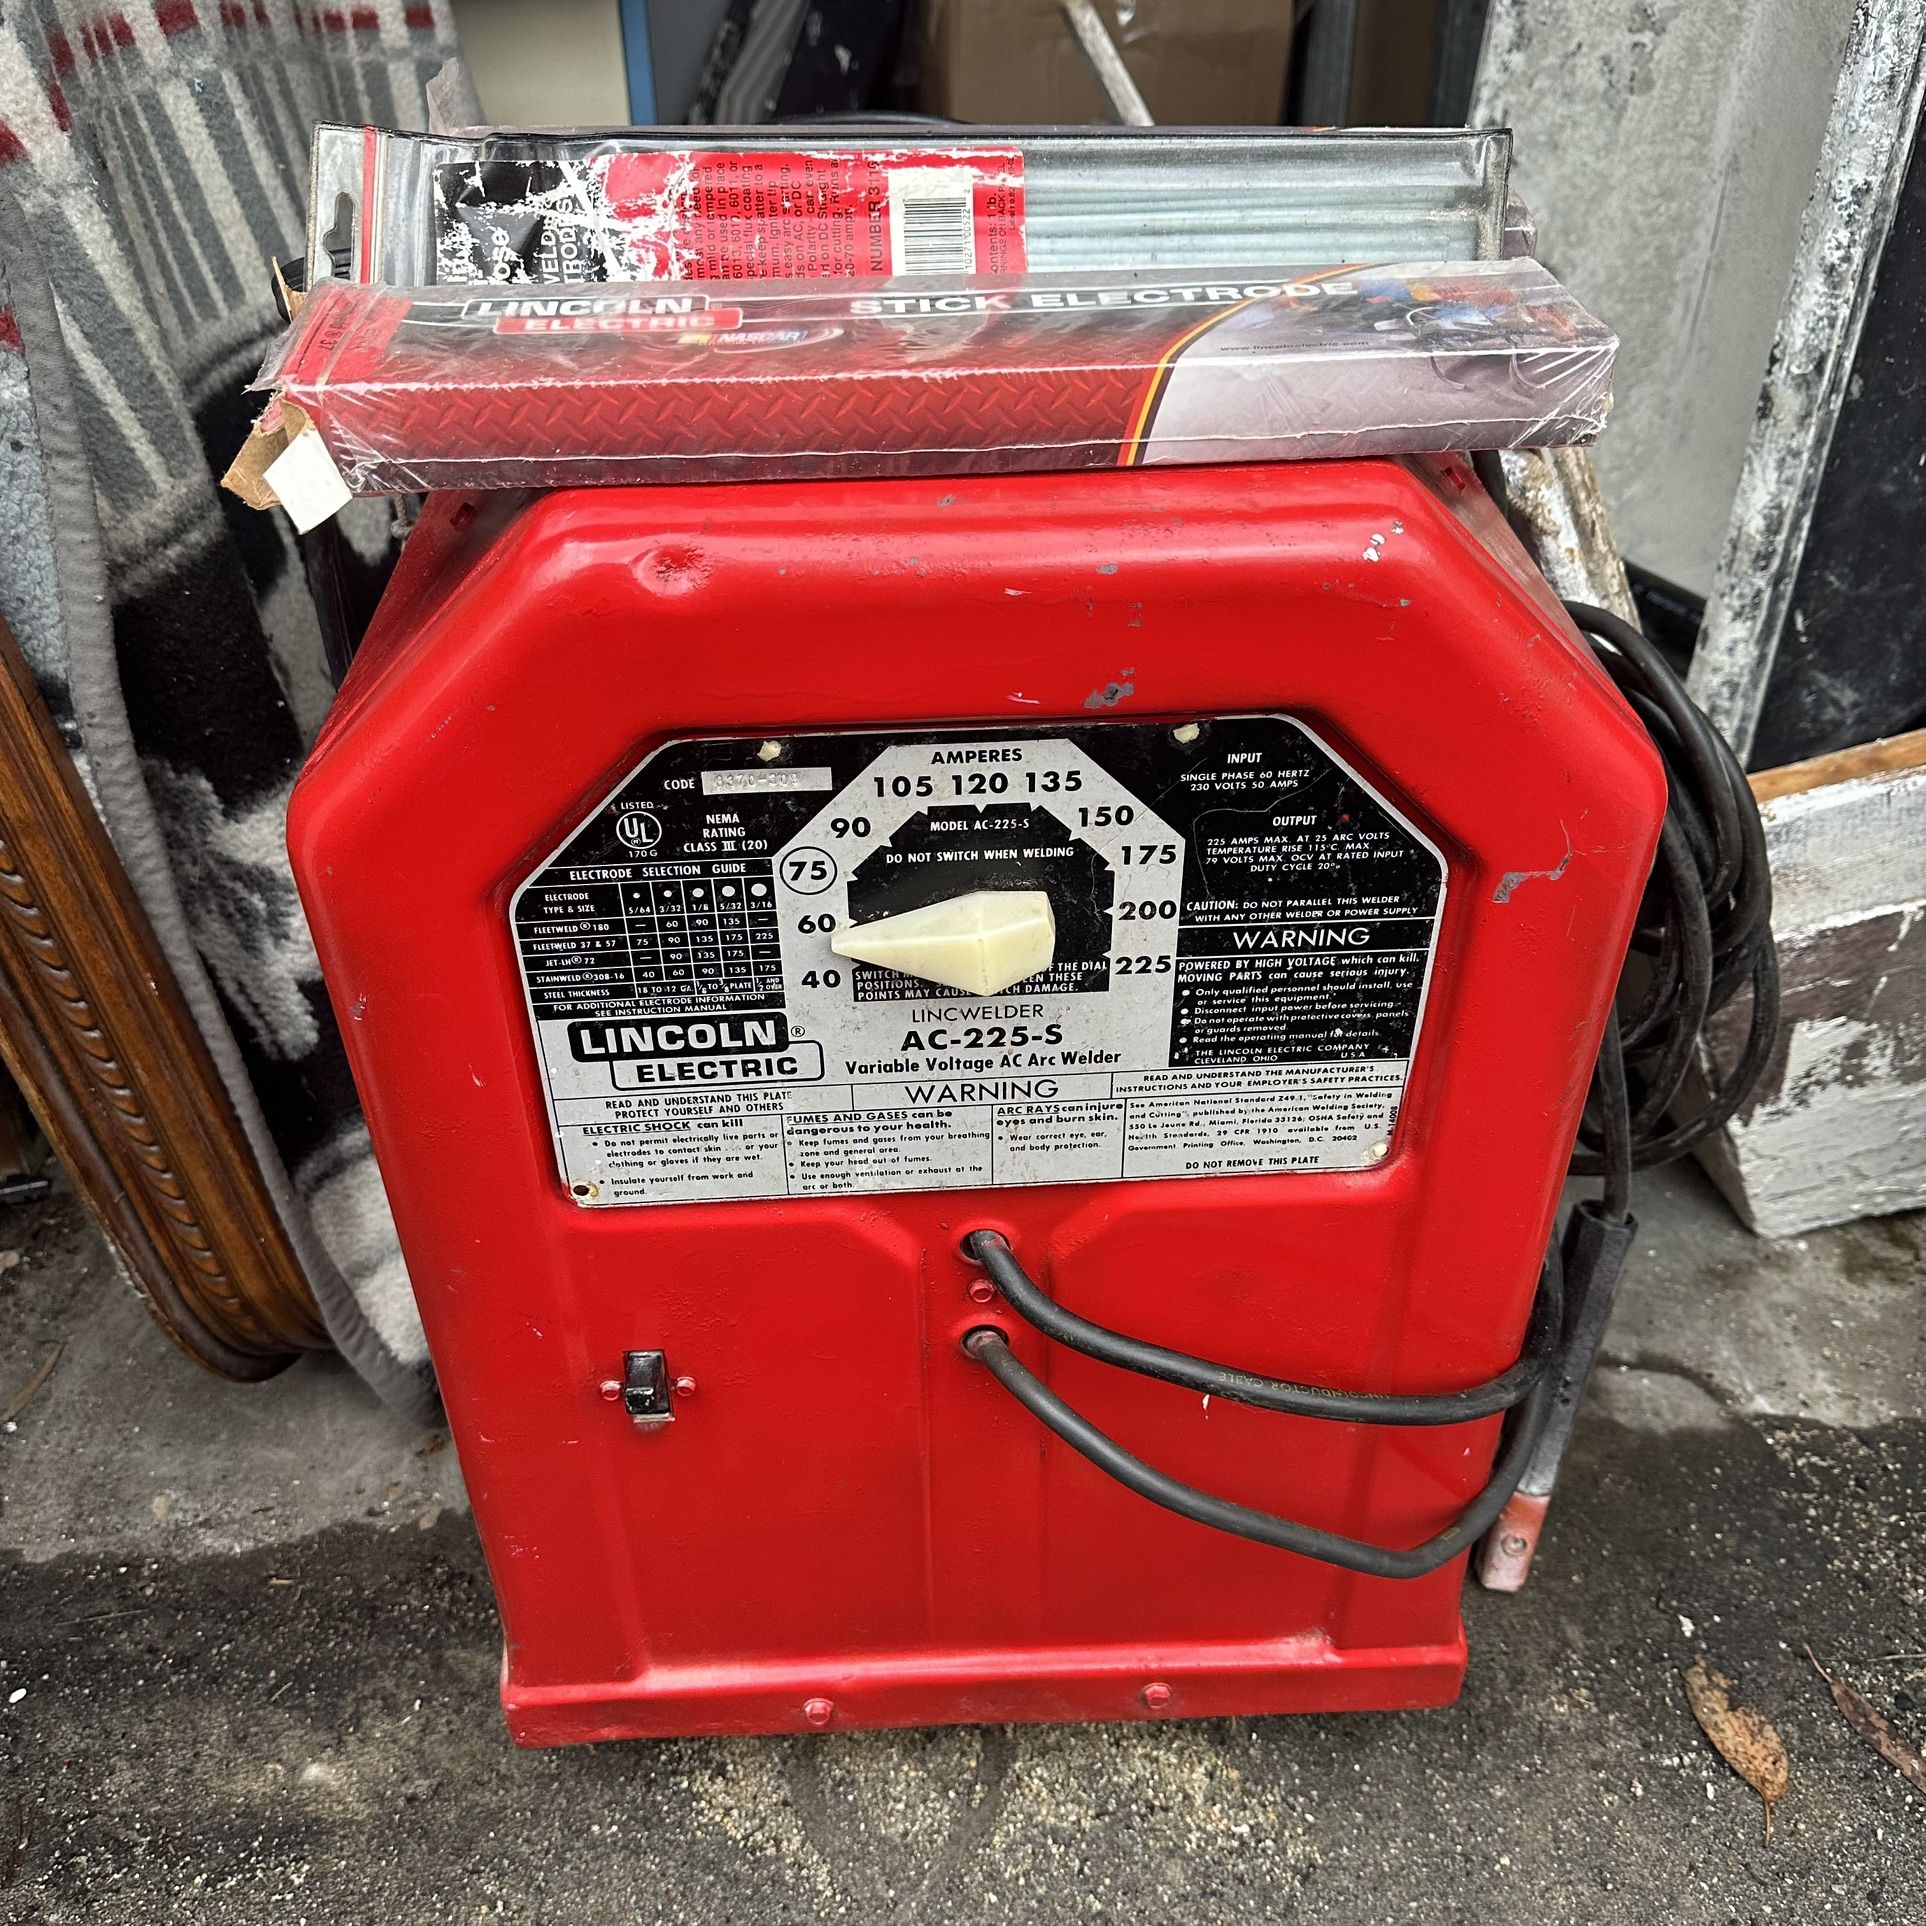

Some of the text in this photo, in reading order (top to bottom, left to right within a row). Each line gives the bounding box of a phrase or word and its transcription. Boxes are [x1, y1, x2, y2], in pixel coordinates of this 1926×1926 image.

[868, 201, 883, 272] NUMBER
[783, 241, 794, 269] easy
[795, 246, 804, 260] on
[848, 281, 1359, 316] STICK ELECTRODE
[477, 298, 693, 317] LINCOLN
[524, 316, 716, 331] ELECTRIC
[930, 748, 1022, 763] AMPERES
[1227, 752, 1262, 763] INPUT
[1025, 770, 1082, 792] 135
[1180, 769, 1309, 781] SINGLE PHASE 60 HERTZ
[663, 778, 694, 789] CODE
[873, 775, 932, 797] 105
[951, 772, 1008, 794] 120
[1214, 781, 1246, 789] VOLTS
[1251, 780, 1264, 788] 50
[1269, 779, 1298, 787] AMPS
[705, 813, 739, 823] NEMA
[1078, 805, 1133, 826] 150
[1272, 815, 1317, 825] OUTPUT
[702, 826, 745, 837] RATING
[830, 817, 870, 838] 90
[930, 818, 1029, 831] MODEL AC-225-S
[1230, 836, 1258, 844] AMPS
[1296, 834, 1309, 842] AT
[1358, 831, 1389, 839] VOLTS
[683, 841, 716, 852] CLASS
[741, 839, 767, 850] (20)
[1206, 844, 1302, 854] TEMPERATURE RISE
[886, 847, 1073, 863] DO NOT SWITCH WHEN WELDING
[1121, 844, 1176, 864] 175
[1222, 850, 1403, 863] VOLTS RATED INPUT
[569, 863, 746, 880] ELECTRODE SELECTION GUIDE
[788, 860, 827, 880] 75
[1281, 862, 1312, 870] CYCLE
[544, 892, 589, 901] ELECTRODE
[1186, 900, 1238, 910] CAUTION:
[1286, 898, 1331, 906] PARALLEL
[1361, 895, 1399, 903] WELDER
[577, 904, 594, 912] SIZE
[1118, 900, 1176, 920] 200
[1249, 911, 1281, 920] OTHER
[723, 917, 740, 925] 135
[797, 913, 836, 933] 60
[605, 939, 615, 947] 57
[1232, 927, 1369, 947] WARNING
[1057, 962, 1077, 971] THE
[1115, 955, 1171, 974] 225
[1178, 960, 1230, 971] POWERED
[1235, 959, 1249, 968] BY
[1254, 958, 1282, 967] HIGH
[1287, 956, 1336, 969] VOLTAGE
[1341, 955, 1372, 964] which
[801, 969, 840, 988] 40
[1048, 971, 1082, 981] THESE
[1177, 972, 1222, 982] MOVING
[1229, 970, 1261, 980] PARTS
[1330, 969, 1367, 977] serious
[543, 989, 609, 999] STEEL THICKNESS
[857, 988, 929, 1000] POINTS MAY
[553, 993, 764, 1011] FOR ADDITIONAL ELECTRODE INFORMATION
[615, 1006, 680, 1015] INSTRUCTION
[912, 1004, 1043, 1022] LINCWELDER
[580, 1021, 776, 1053] LINCOLN
[900, 1024, 1062, 1050] AC-225-S
[636, 1057, 797, 1082] ELECTRIC
[845, 1050, 1121, 1074] Variable Voltage AC Arc Welder
[904, 1079, 1058, 1102] WARNING
[605, 1092, 758, 1108] READ AND UNDERSTAND THIS
[614, 1102, 783, 1118] PROTECT YOURSELF AND OTHERS
[1185, 1155, 1319, 1169] DO NOT REMOVE THIS PLATE
